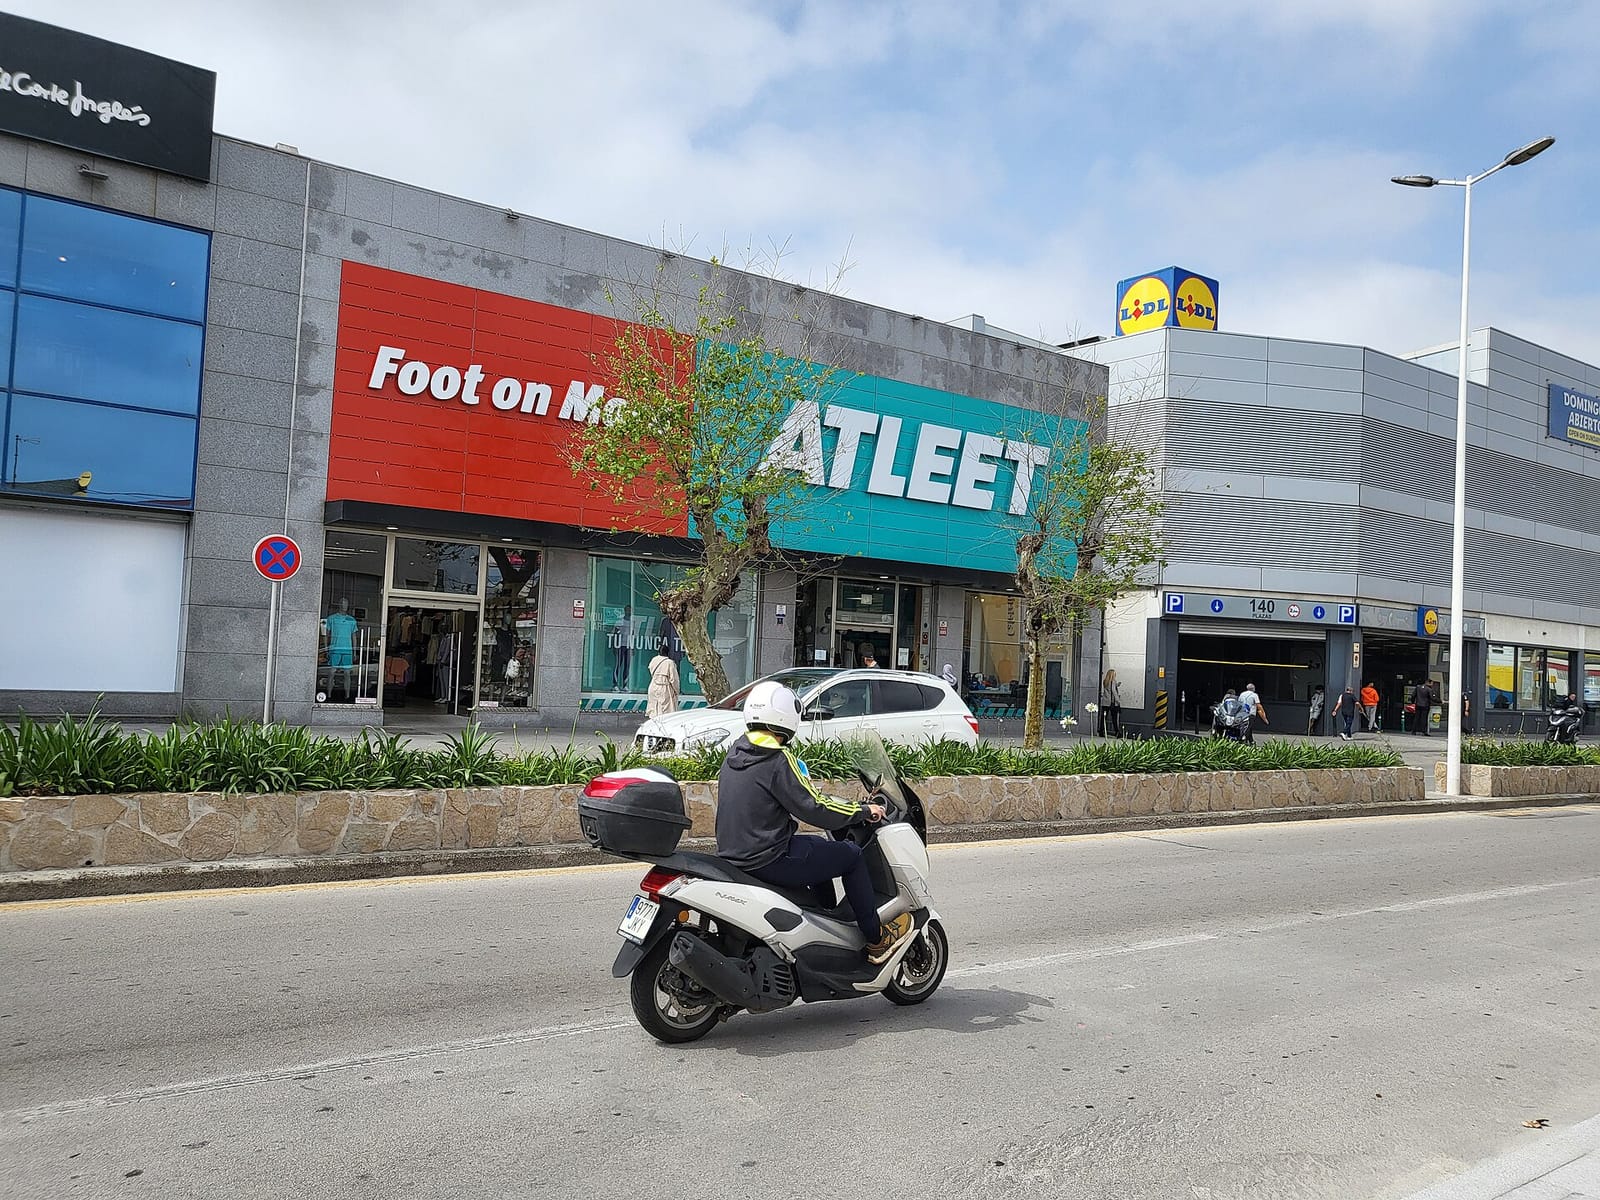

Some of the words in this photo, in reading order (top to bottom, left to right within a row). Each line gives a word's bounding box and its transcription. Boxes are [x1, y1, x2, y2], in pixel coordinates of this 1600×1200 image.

[12, 72, 69, 106] Corte
[368, 345, 486, 405] Foot
[491, 376, 553, 416] on
[1563, 391, 1600, 416] DOMING
[756, 400, 1051, 516] ATLEET
[1249, 599, 1275, 614] 140
[606, 630, 622, 649] TÚ
[626, 634, 668, 651] NUNCA
[635, 901, 658, 921] 9771
